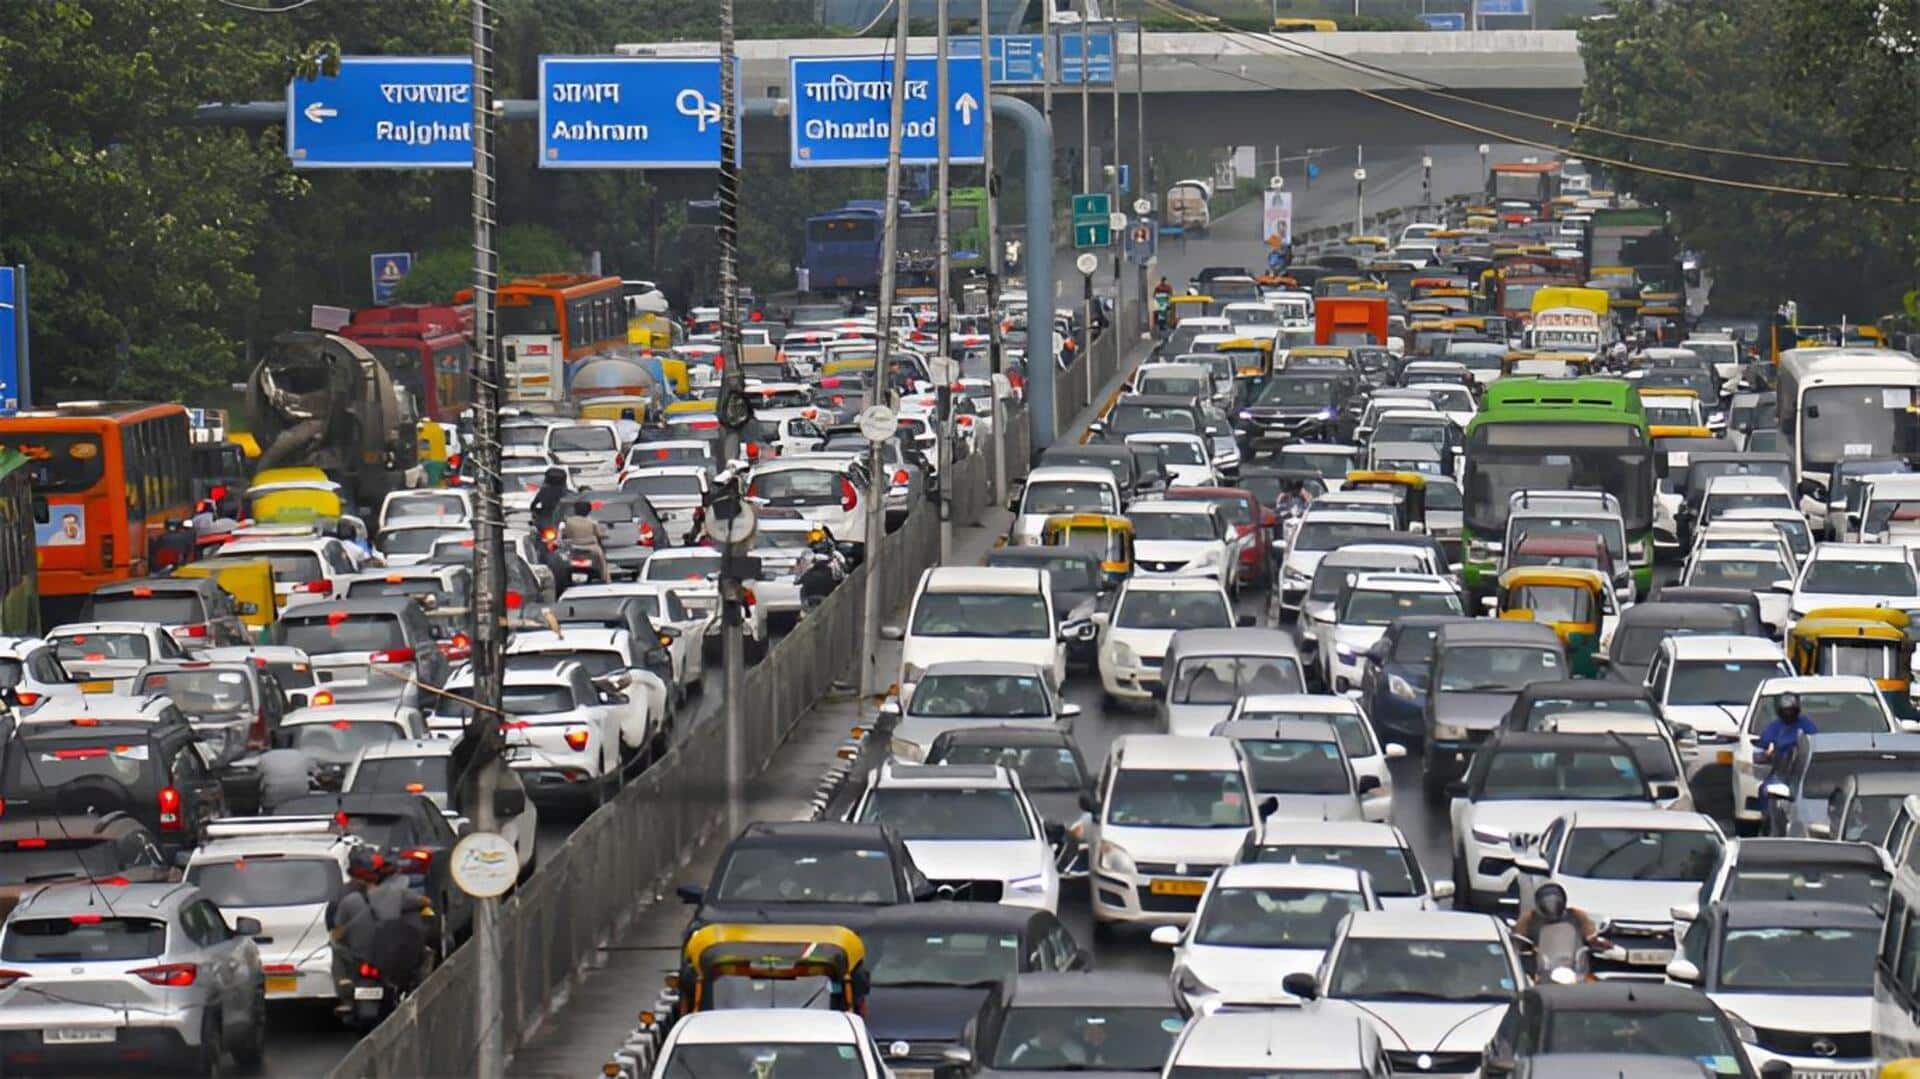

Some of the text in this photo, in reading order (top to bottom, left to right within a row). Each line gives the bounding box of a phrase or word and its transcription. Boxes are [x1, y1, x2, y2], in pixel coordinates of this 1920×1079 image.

[377, 120, 471, 145] Rajghat
[552, 120, 648, 140] Ashram
[806, 117, 936, 139] Ghaziaad
